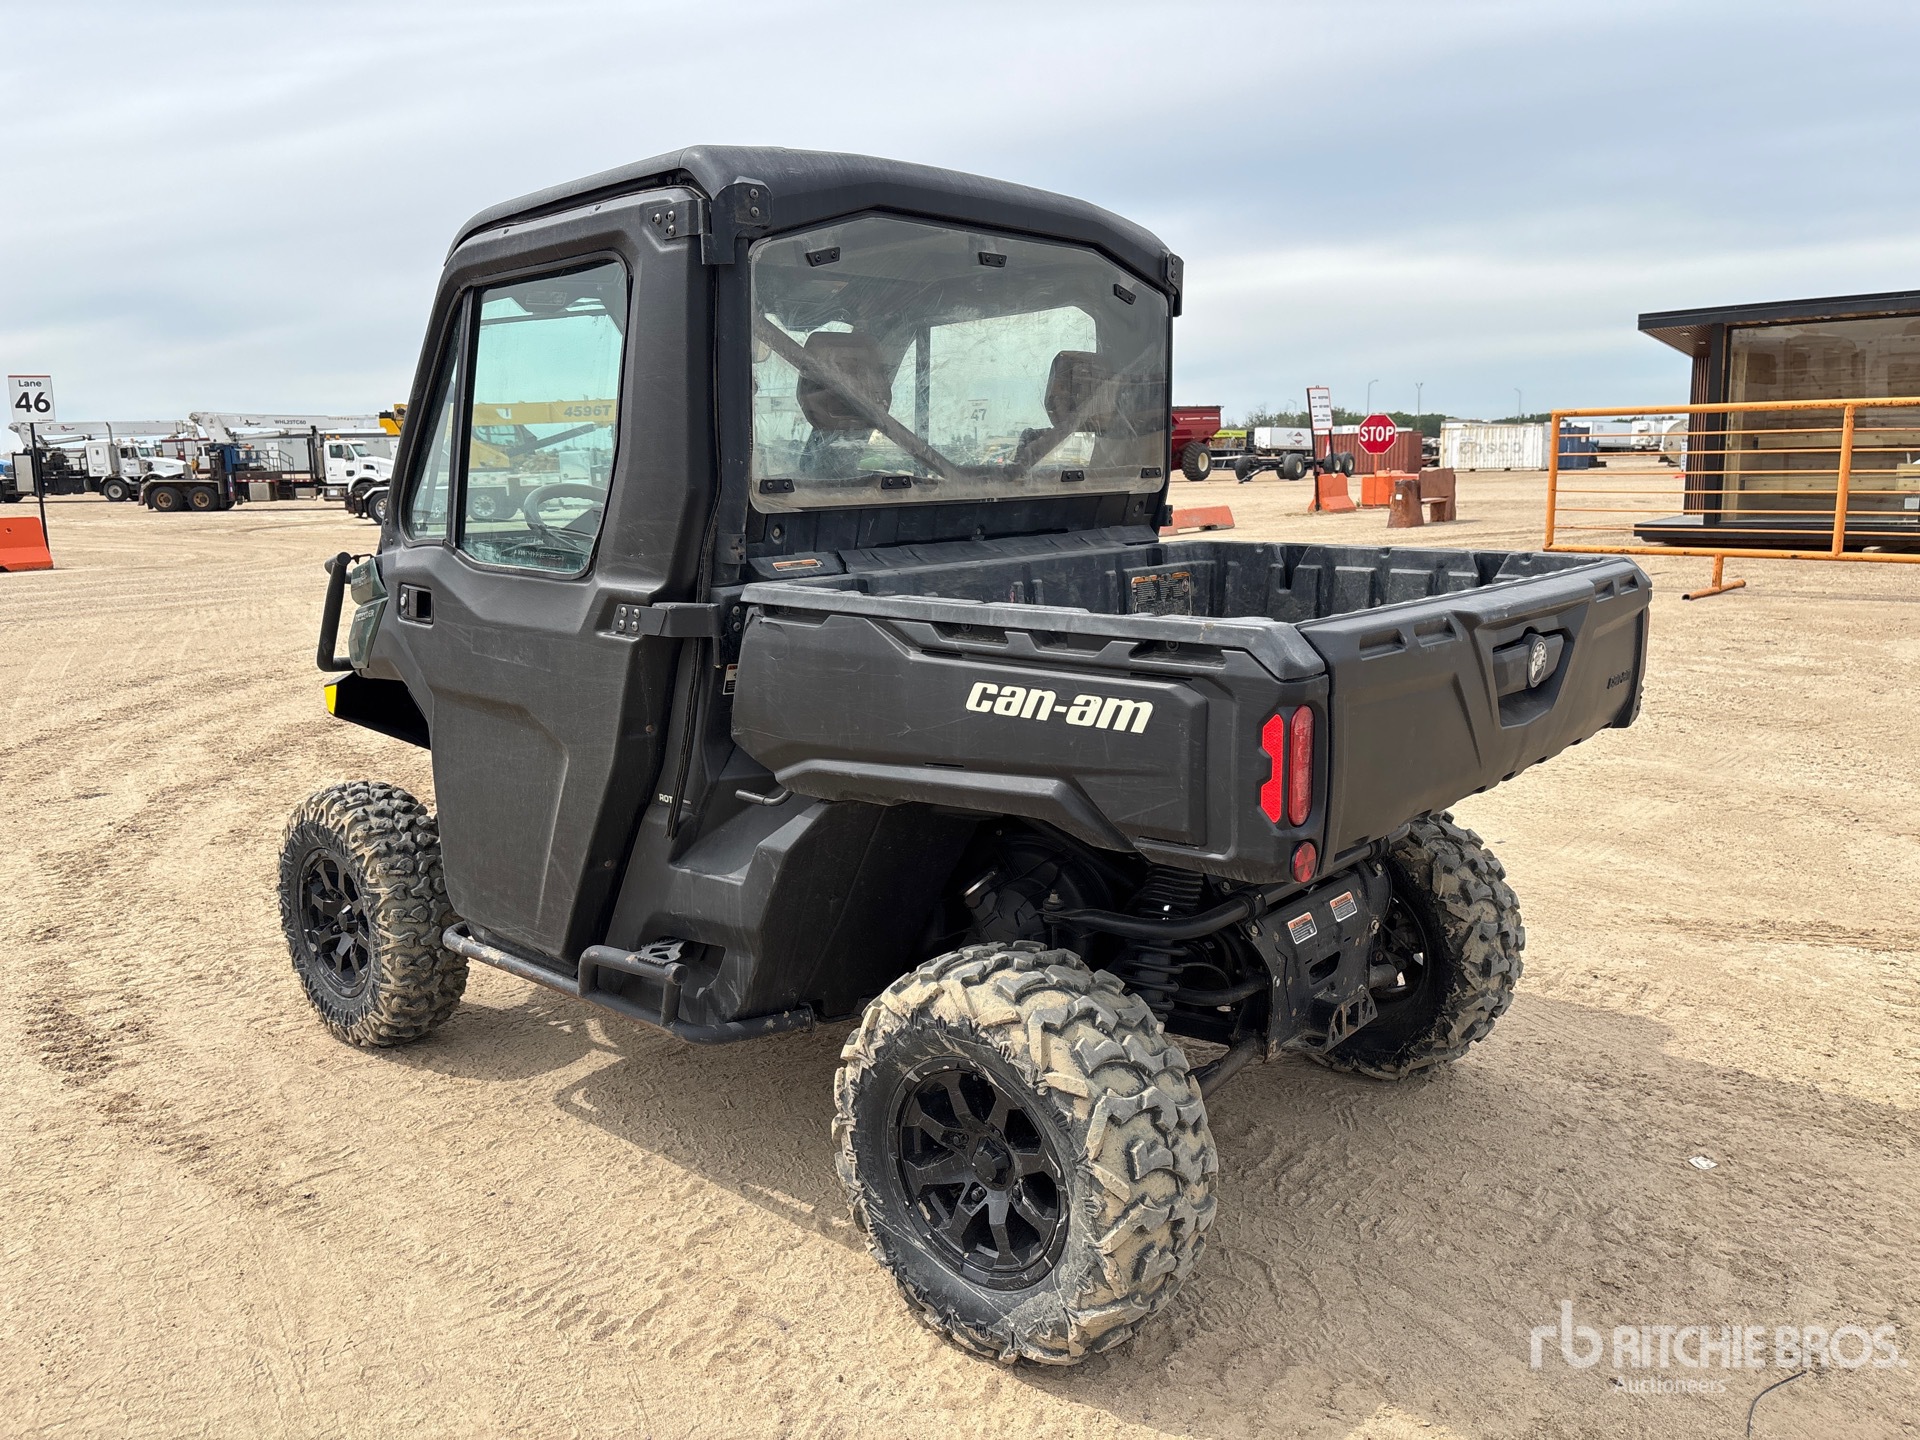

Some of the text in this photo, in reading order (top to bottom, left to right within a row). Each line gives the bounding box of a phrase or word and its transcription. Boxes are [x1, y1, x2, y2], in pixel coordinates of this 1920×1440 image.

[15, 391, 51, 413] 46
[563, 404, 612, 417] 4596T
[970, 408, 987, 421] 47
[1360, 426, 1395, 442] STOP
[965, 681, 1153, 734] can-am
[658, 793, 673, 804] ROT
